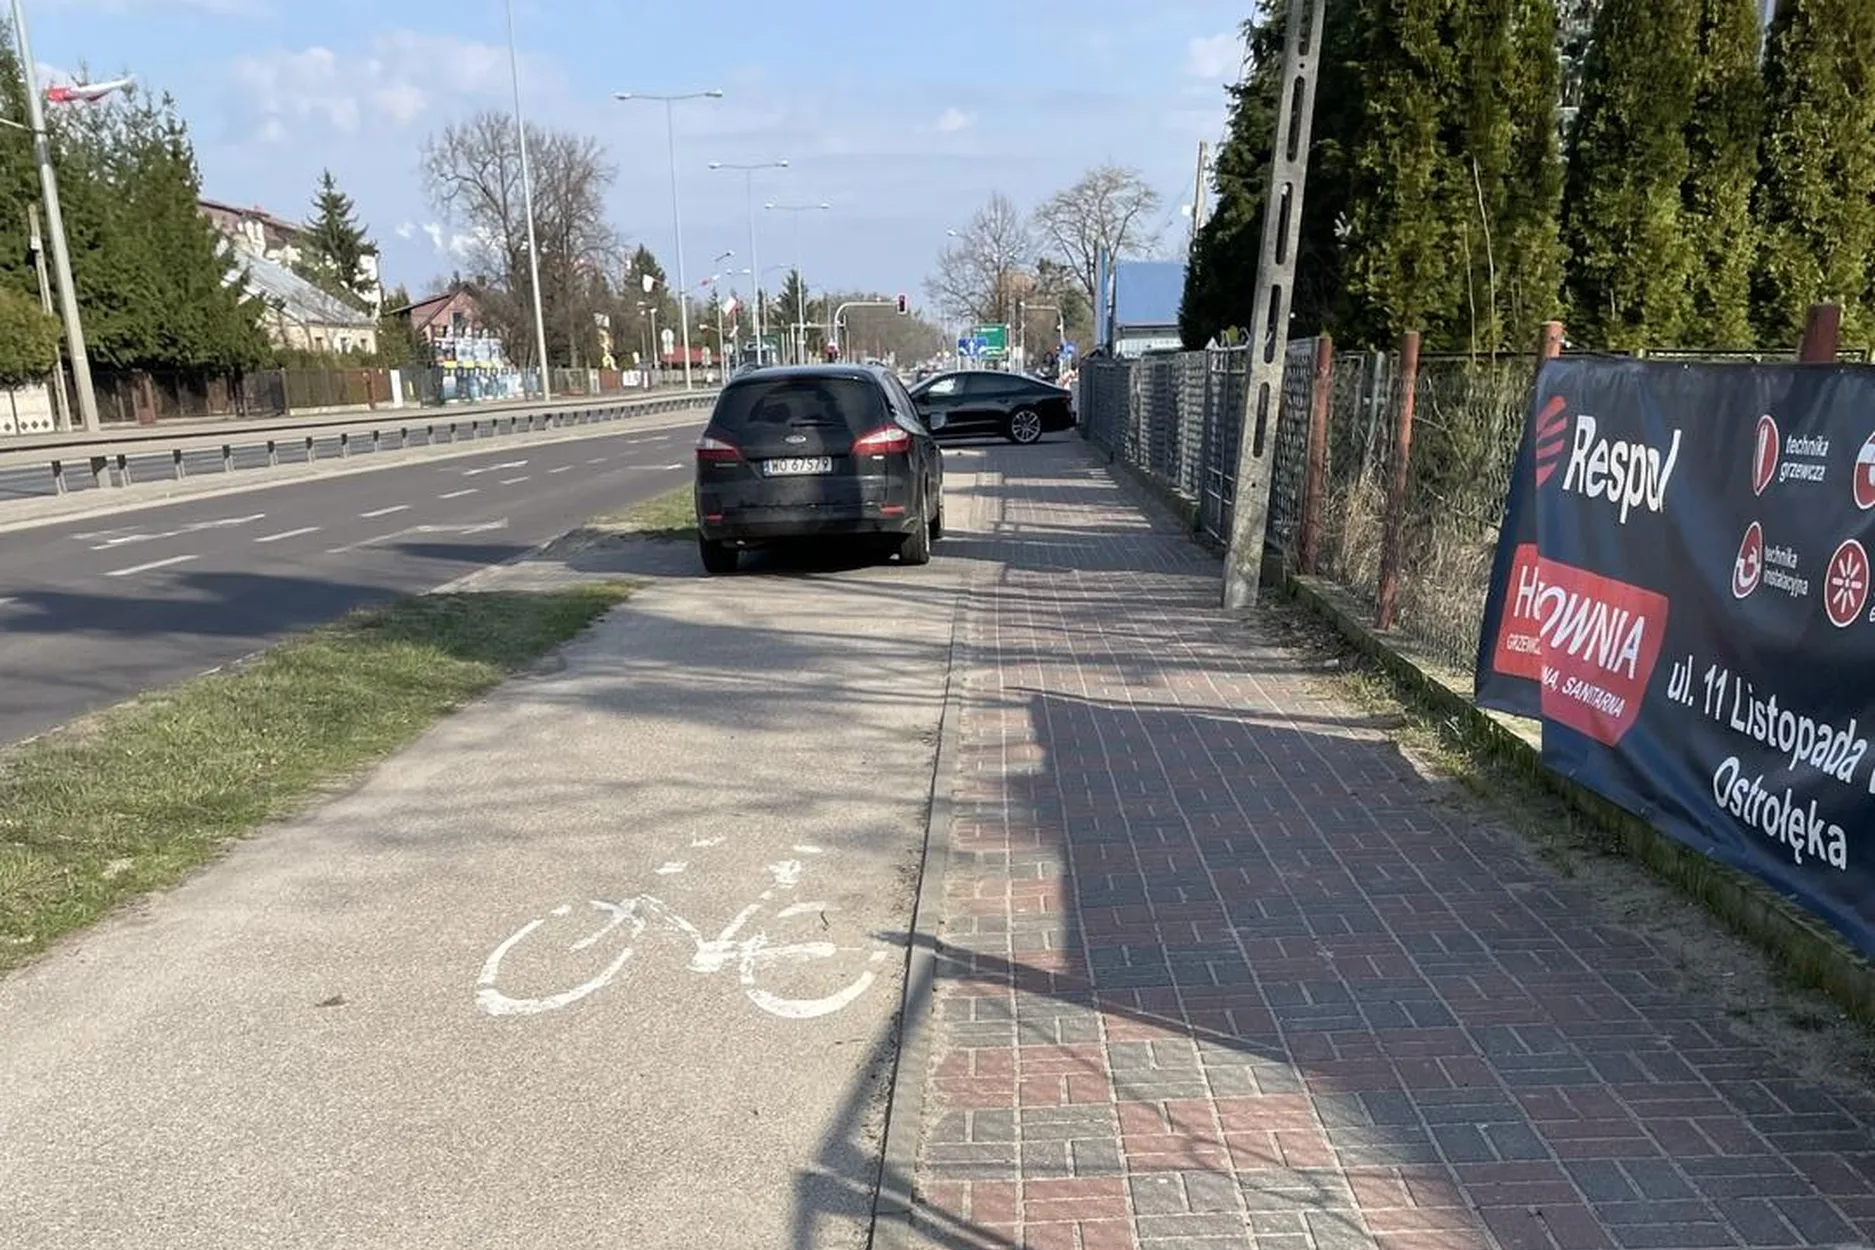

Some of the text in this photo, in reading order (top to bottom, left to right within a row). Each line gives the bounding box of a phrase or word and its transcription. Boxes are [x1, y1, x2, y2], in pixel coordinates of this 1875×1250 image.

[1785, 434, 1829, 457] technika
[1562, 414, 1682, 524] Respol
[1778, 461, 1826, 483] grzewcza
[1763, 544, 1798, 569] technika
[1763, 567, 1809, 598] instalacyjna
[1561, 676, 1626, 718] SANITARNA
[1666, 654, 1694, 707] ul.
[1703, 663, 1729, 720] 11
[1729, 676, 1869, 784] Listopada
[1712, 755, 1848, 870] Ostrołęka
